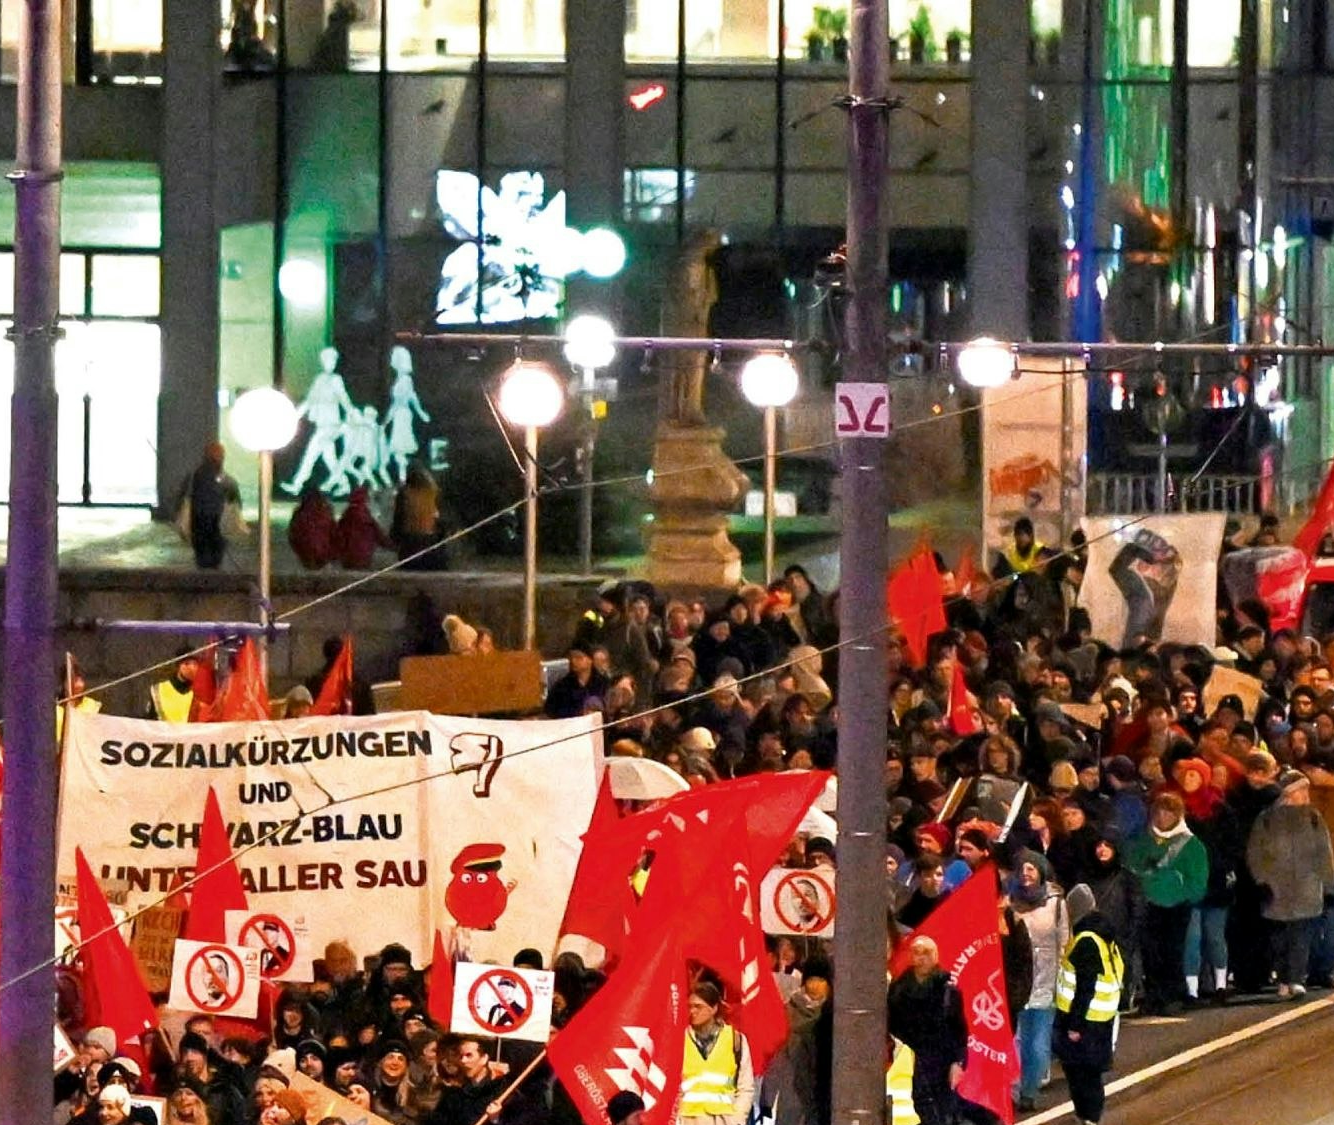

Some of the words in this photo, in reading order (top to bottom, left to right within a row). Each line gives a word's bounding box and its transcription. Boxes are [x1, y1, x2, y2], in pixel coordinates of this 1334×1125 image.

[100, 730, 433, 768] SOZIALKÜRZUNGEN
[238, 781, 293, 804] UND
[100, 863, 198, 894] UNTE
[240, 862, 352, 894] ALLER
[355, 859, 428, 889] SAU
